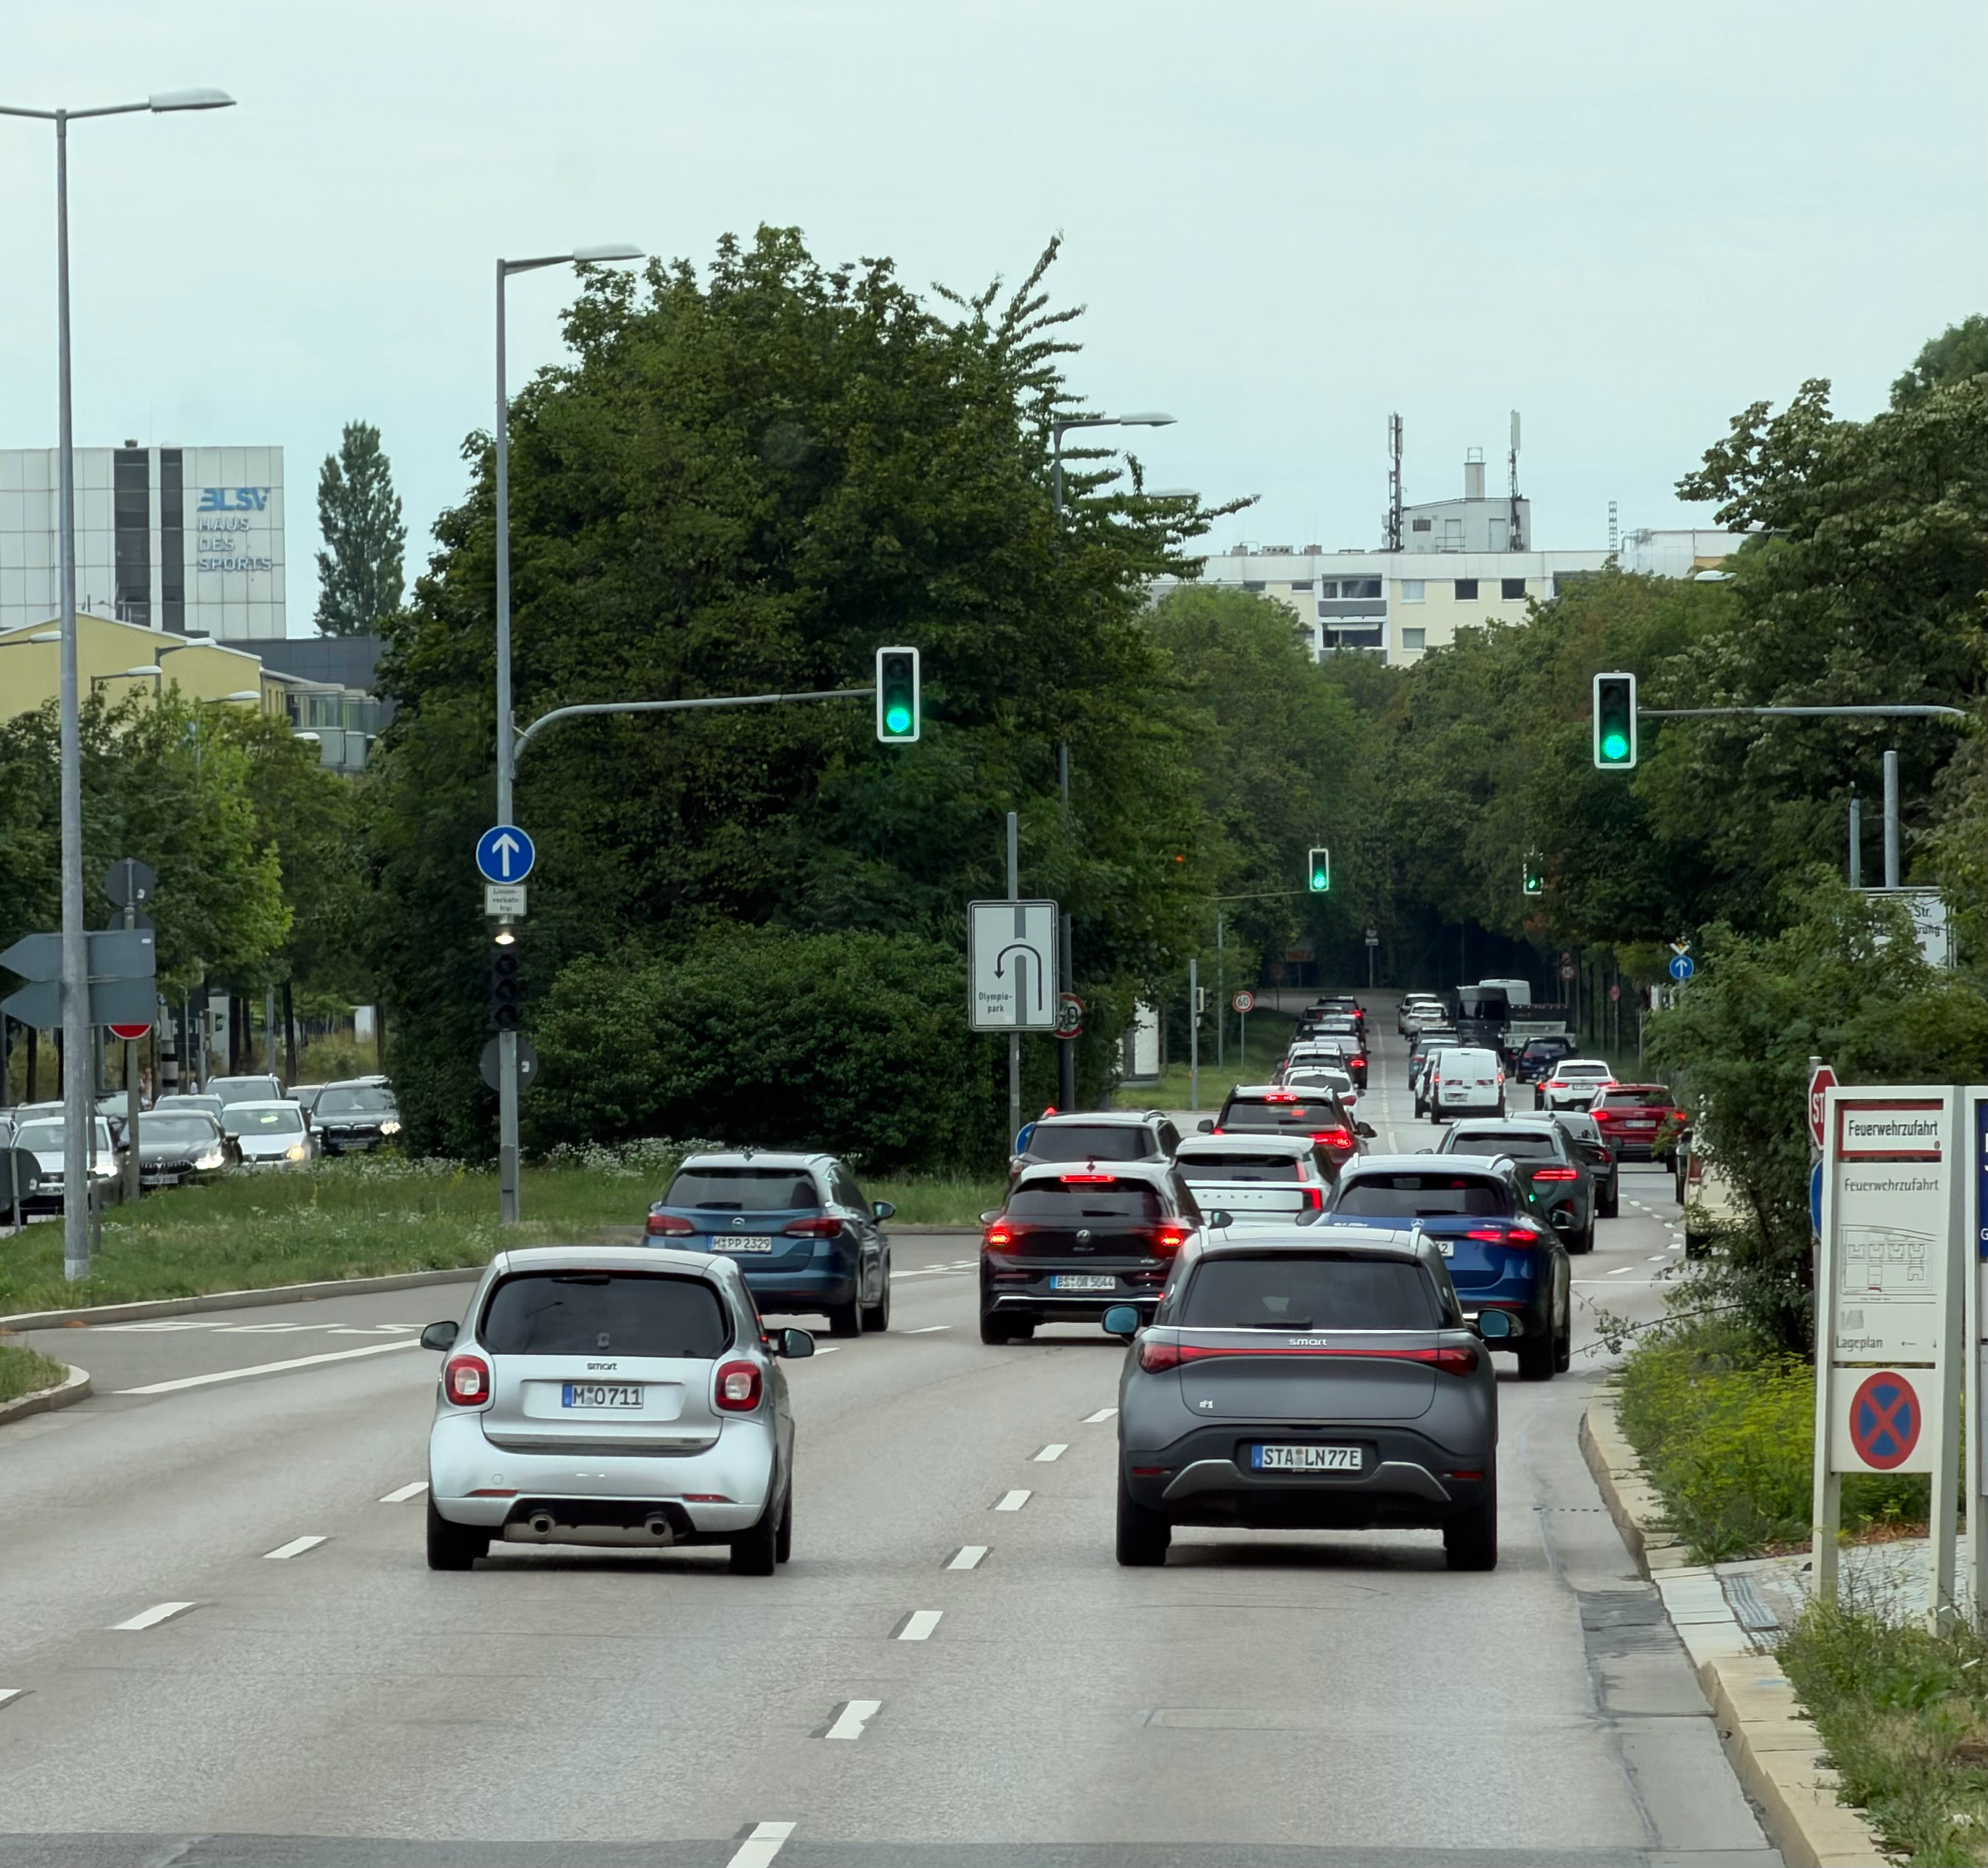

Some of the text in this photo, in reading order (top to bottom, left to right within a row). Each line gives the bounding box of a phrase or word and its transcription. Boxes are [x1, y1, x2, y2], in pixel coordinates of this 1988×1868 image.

[199, 518, 249, 531] HAUS
[199, 538, 234, 552] DES
[199, 558, 271, 572] SPORTS
[988, 1004, 1004, 1014] park
[1813, 1093, 1825, 1123] ST
[1848, 1119, 1938, 1136] Feuerwehrzufahrt
[1845, 1178, 1939, 1191] Feuerwehrzufahrt
[1835, 1335, 1883, 1352] Lageplan
